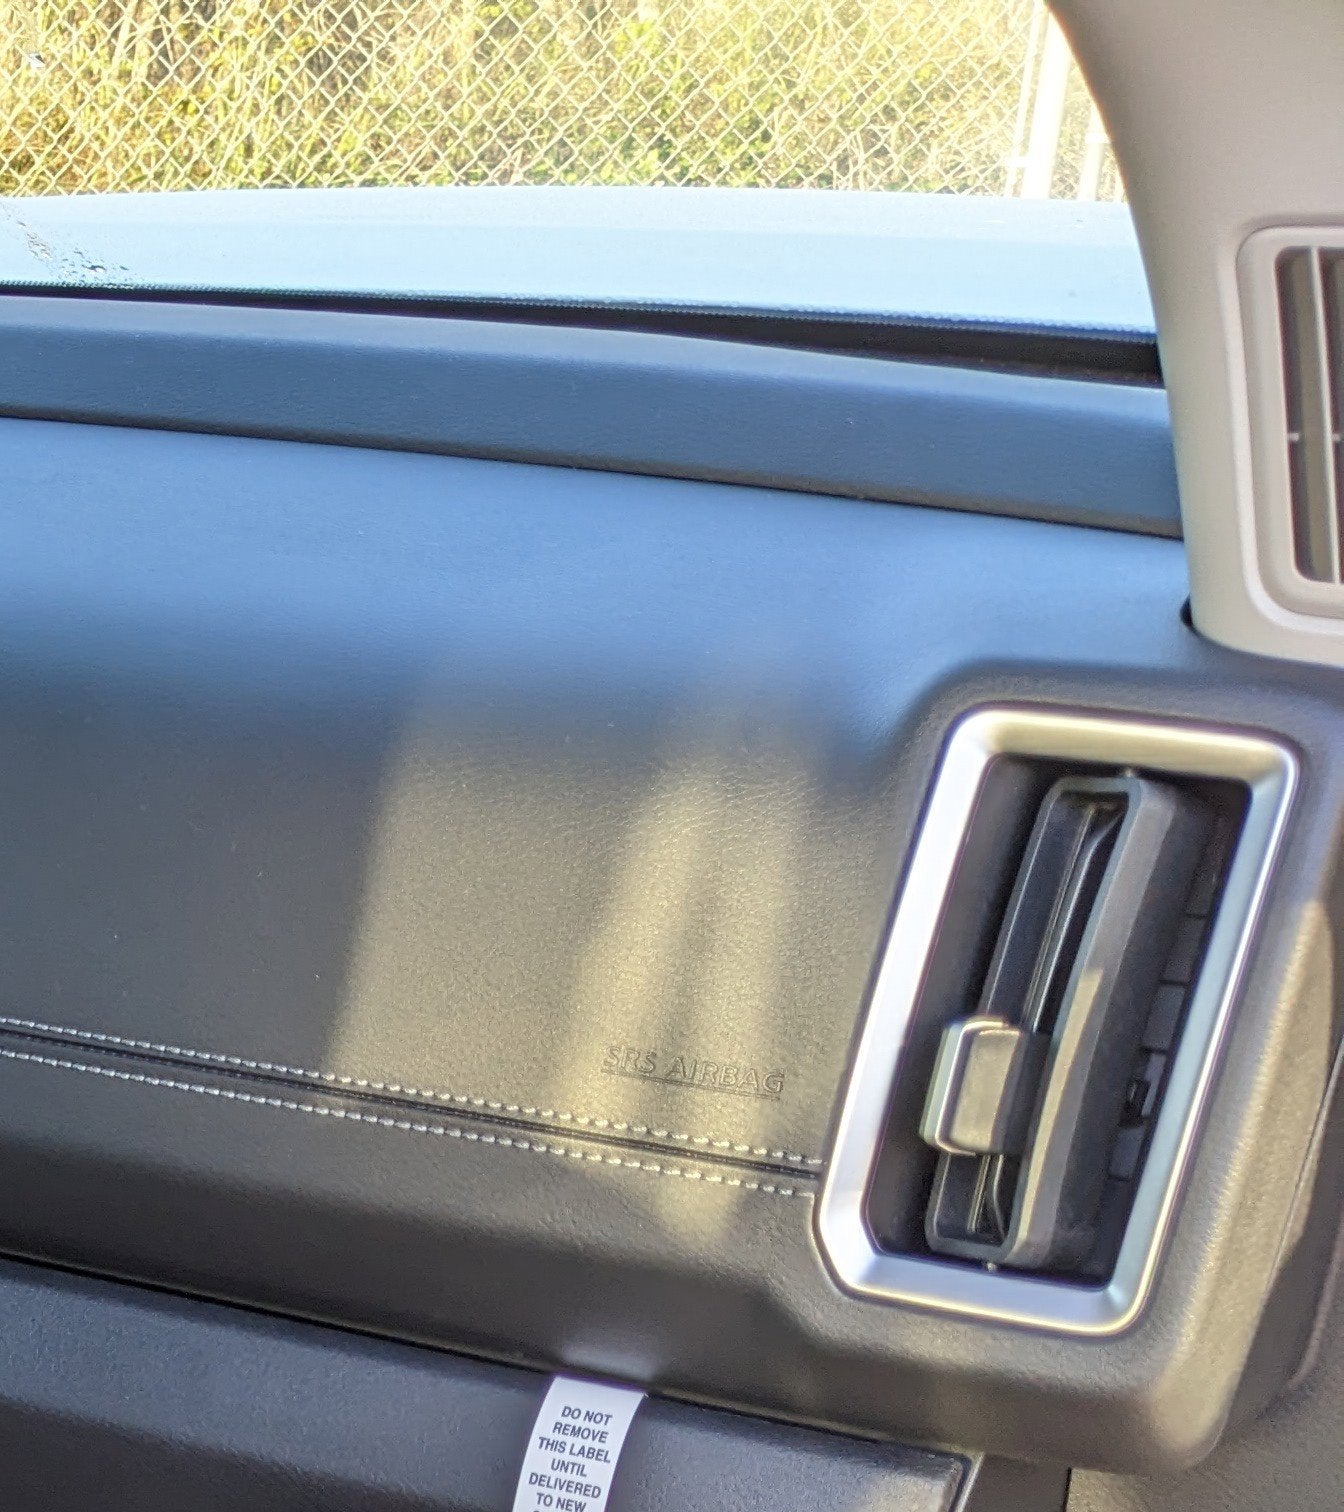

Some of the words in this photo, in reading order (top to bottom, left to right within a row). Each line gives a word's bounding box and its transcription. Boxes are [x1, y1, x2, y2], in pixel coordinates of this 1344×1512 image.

[604, 1045, 657, 1075] SRS
[666, 1055, 785, 1094] AIRBAG
[561, 1405, 581, 1420] DO
[583, 1410, 613, 1426] NOT
[552, 1421, 609, 1443] REMOVE
[538, 1436, 567, 1454] THIS
[569, 1443, 611, 1464] LABEL
[550, 1458, 588, 1478] UNTIL
[528, 1472, 602, 1499] DELIVERED
[536, 1492, 553, 1507] TO
